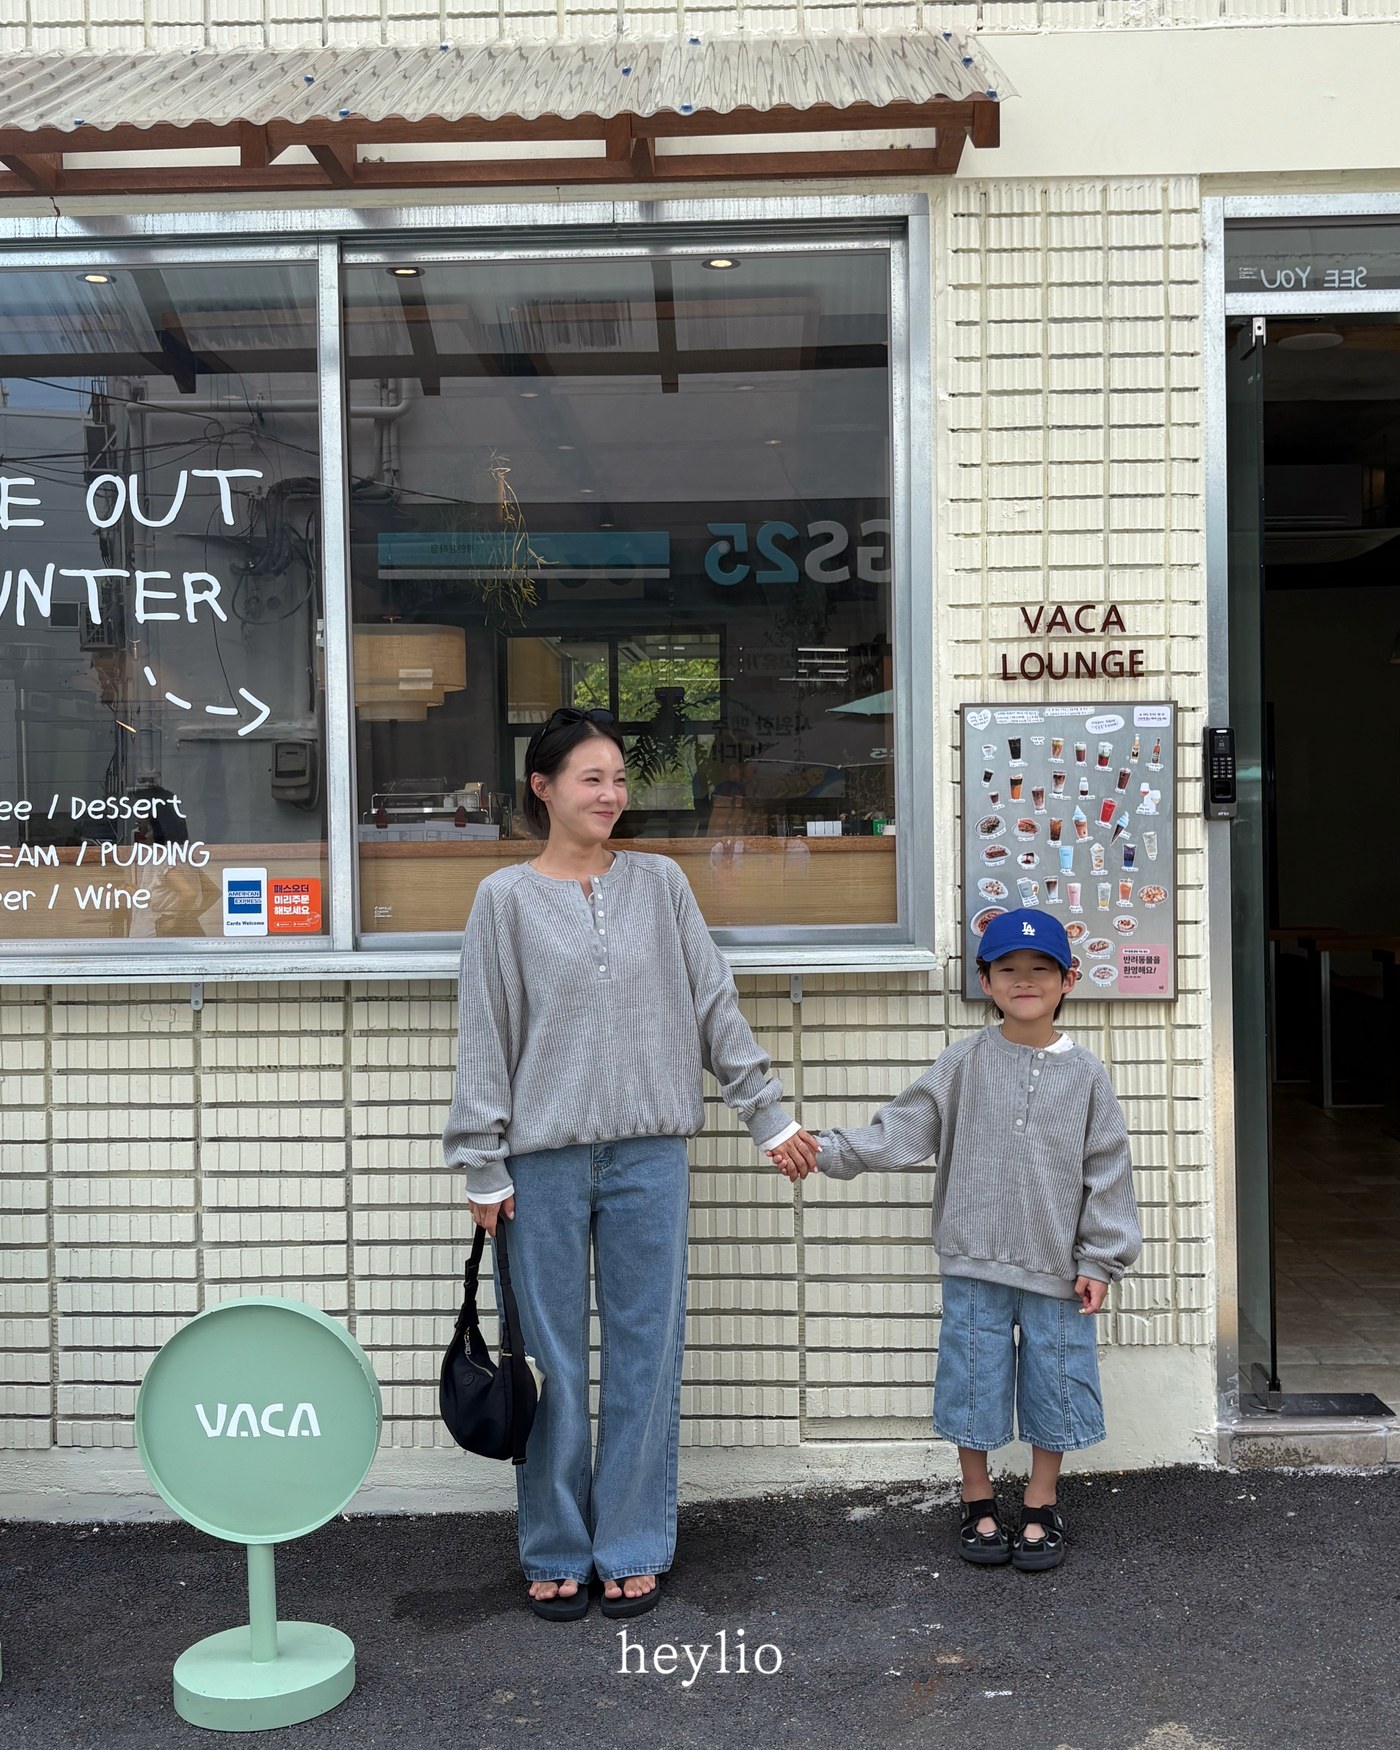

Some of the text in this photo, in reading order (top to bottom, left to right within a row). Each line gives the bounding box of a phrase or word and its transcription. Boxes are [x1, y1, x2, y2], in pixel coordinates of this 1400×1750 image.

[0, 470, 263, 530] E OUT
[1020, 604, 1127, 634] VACA
[1001, 650, 1145, 681] LOUNGE
[71, 794, 187, 820] Dessert
[101, 840, 210, 867] PUDDING
[0, 890, 37, 911] er
[73, 882, 151, 910] Wine
[273, 894, 310, 905] 미리주문
[273, 905, 311, 915] 해보세요
[1022, 921, 1036, 936] LA
[1123, 955, 1161, 965] 반려동물을
[1123, 965, 1157, 975] 환영해요!
[195, 1402, 322, 1438] VACA
